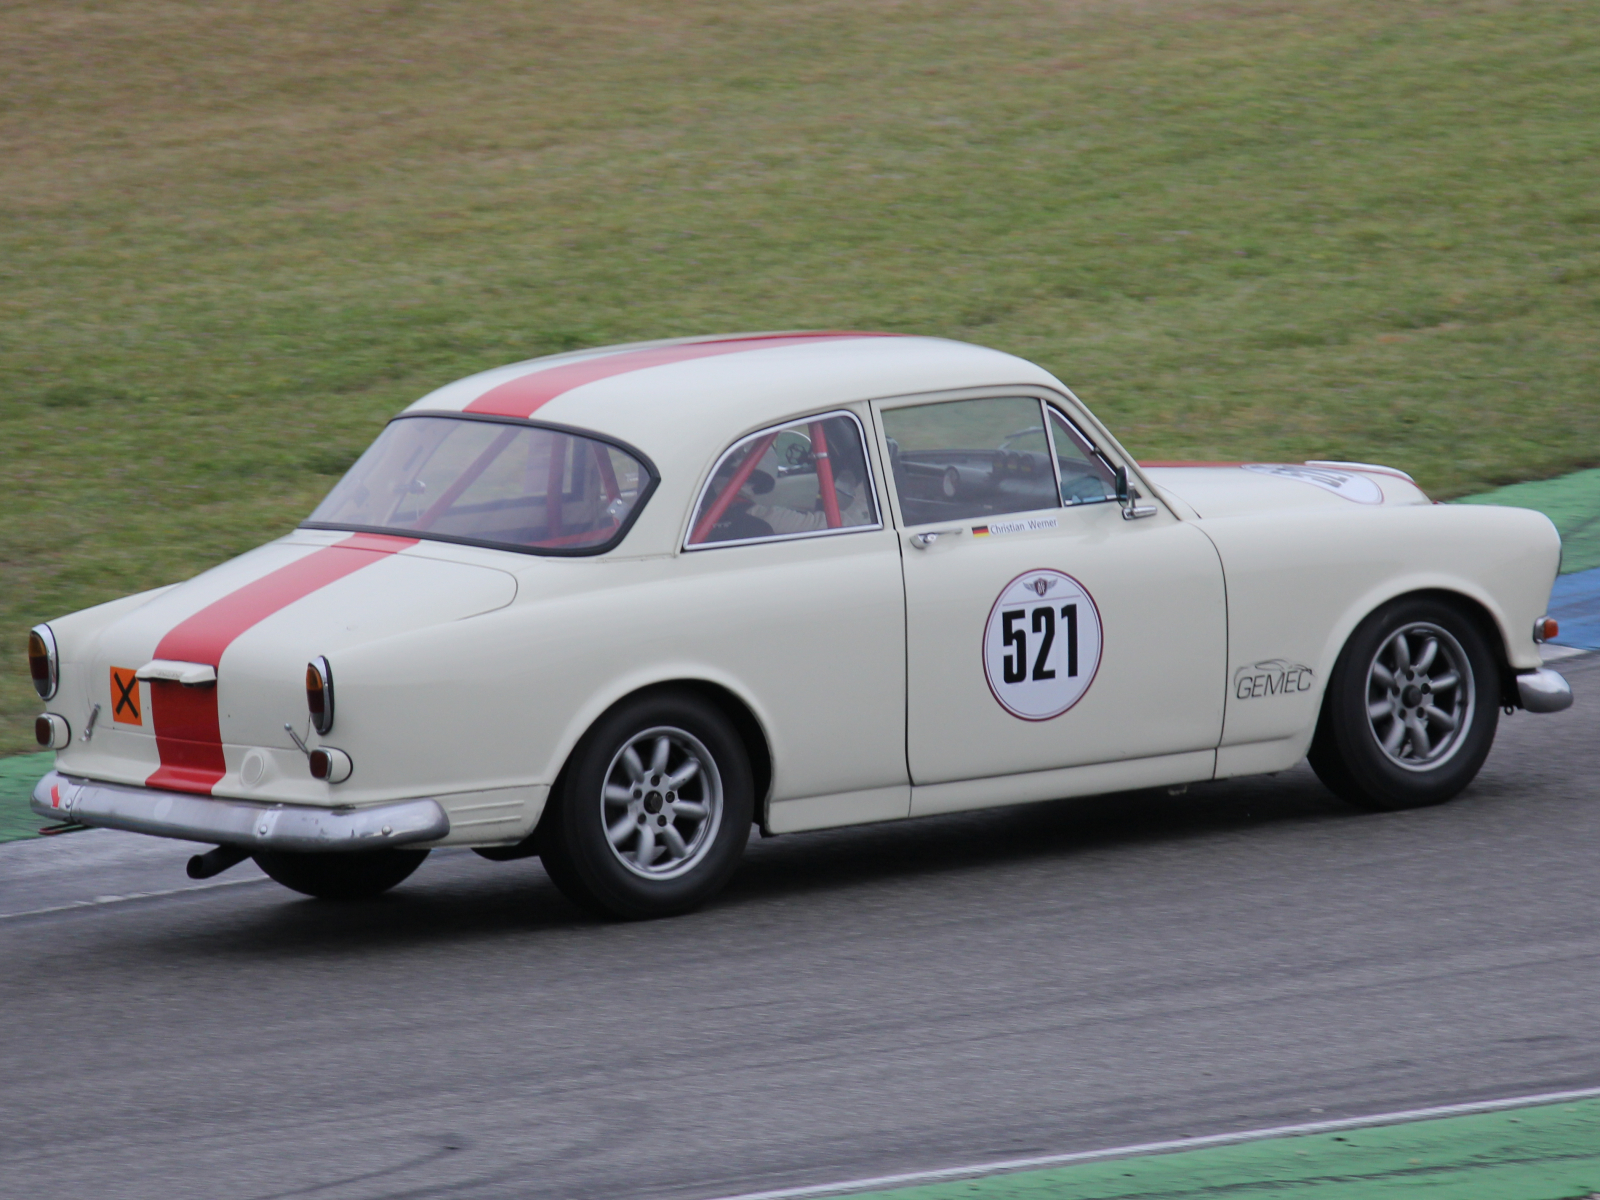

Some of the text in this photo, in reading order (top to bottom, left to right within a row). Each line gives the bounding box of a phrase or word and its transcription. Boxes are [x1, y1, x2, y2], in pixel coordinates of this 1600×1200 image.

[990, 519, 1057, 535] Christian Werner
[1002, 603, 1078, 685] 521
[1236, 668, 1312, 699] GEMEC
